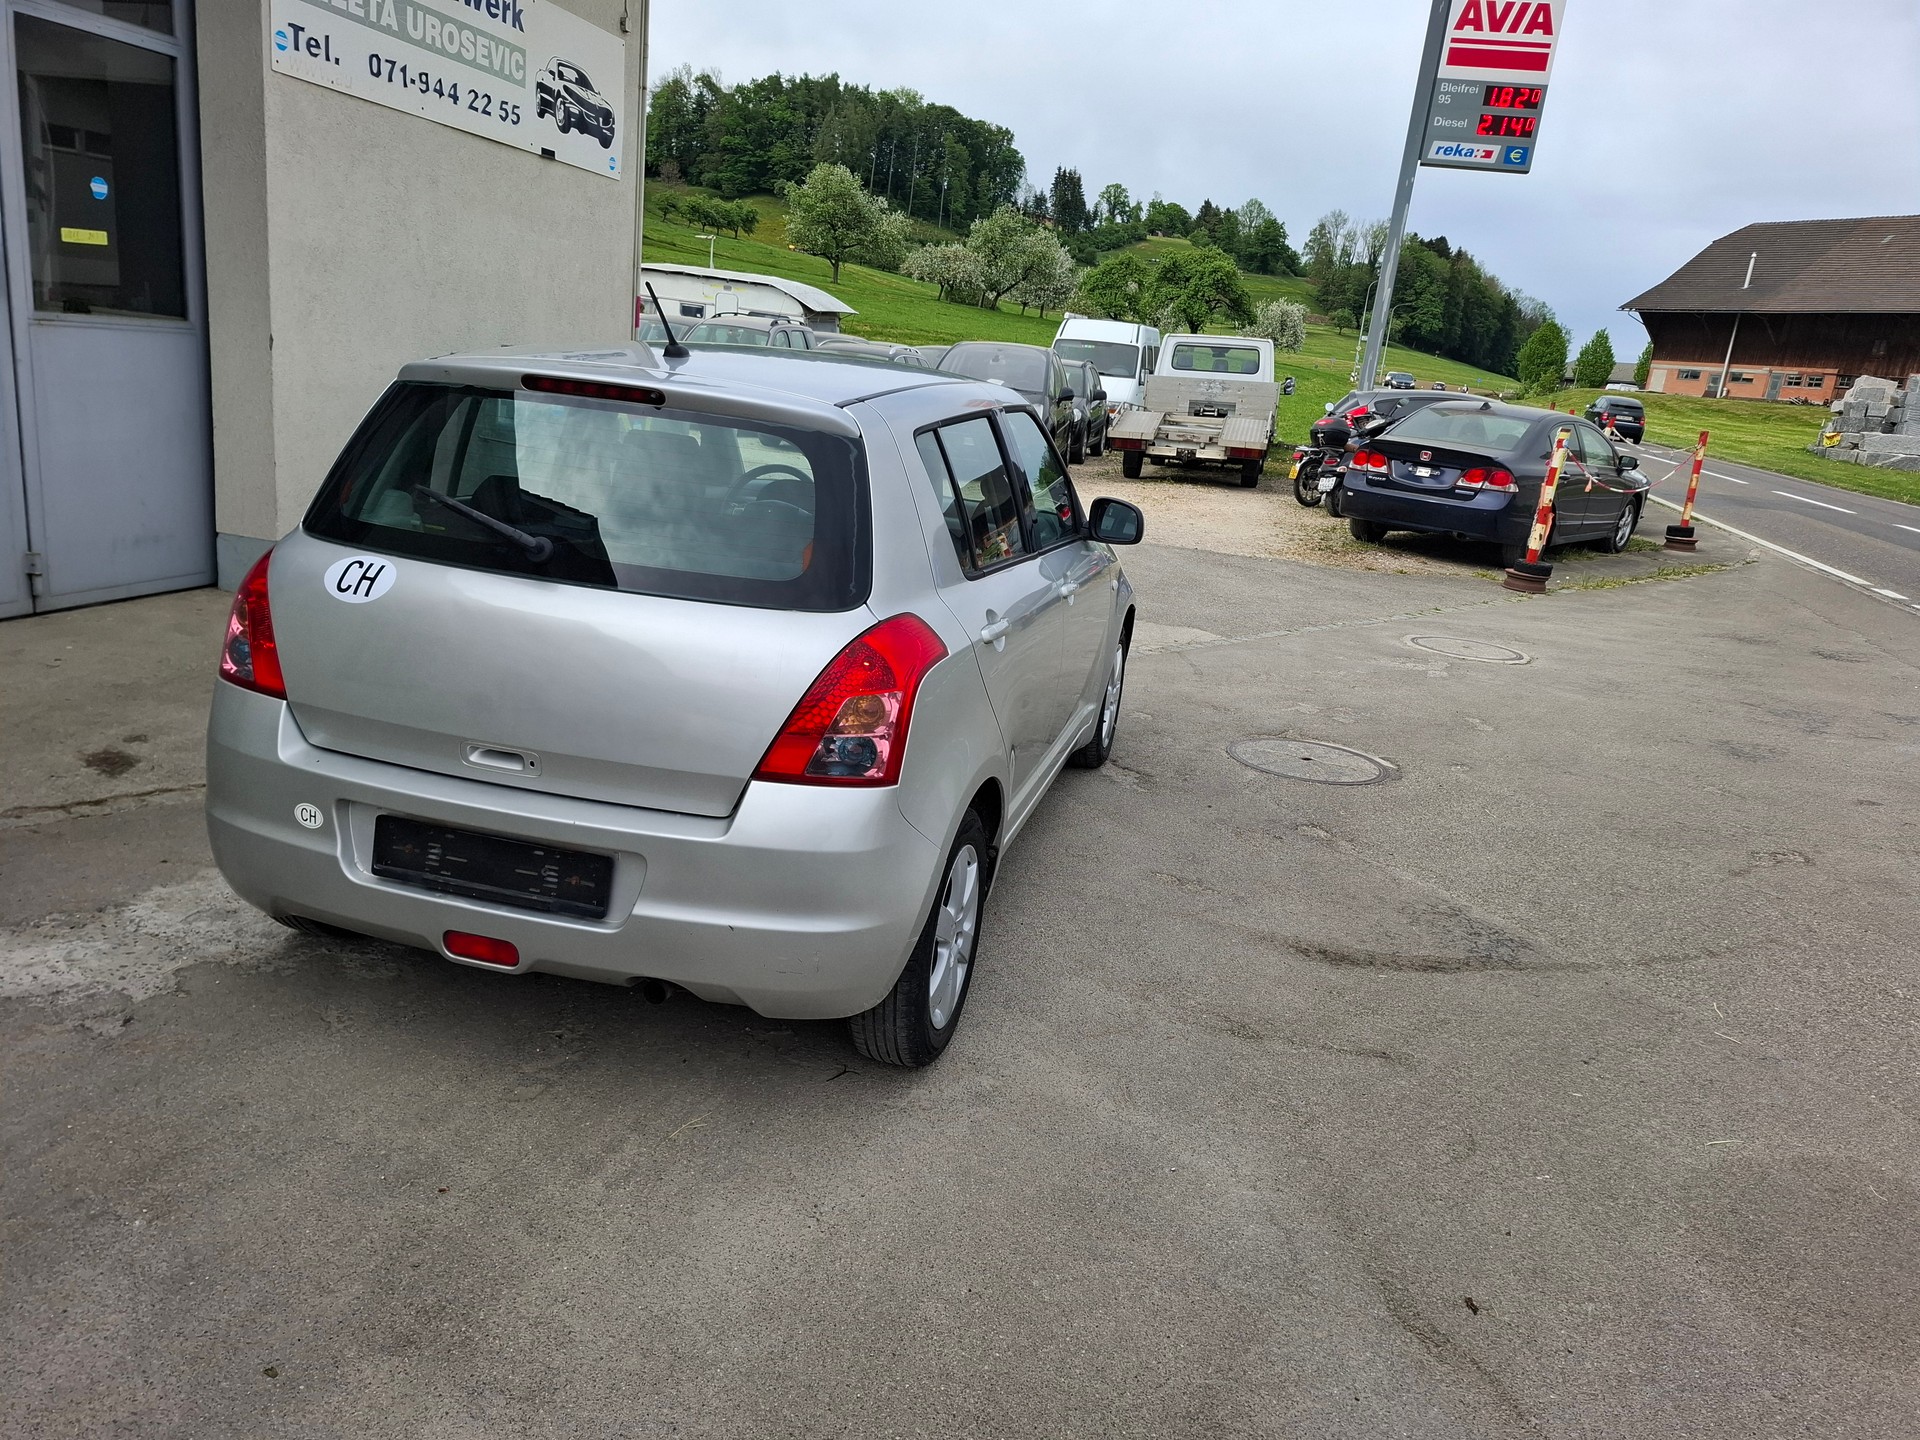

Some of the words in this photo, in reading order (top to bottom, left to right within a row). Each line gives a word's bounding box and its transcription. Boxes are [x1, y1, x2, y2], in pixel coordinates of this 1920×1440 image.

[1453, 0, 1554, 36] AVIA
[406, 6, 524, 80] UROSEVIC
[287, 22, 340, 66] Tel.
[368, 53, 459, 105] 071-944
[467, 89, 492, 116] 22
[499, 100, 520, 125] 55
[1438, 94, 1451, 104] 95
[1440, 82, 1479, 94] Bleifrei
[1434, 117, 1468, 128] Diesel
[336, 560, 387, 598] CH
[301, 807, 317, 825] CH
